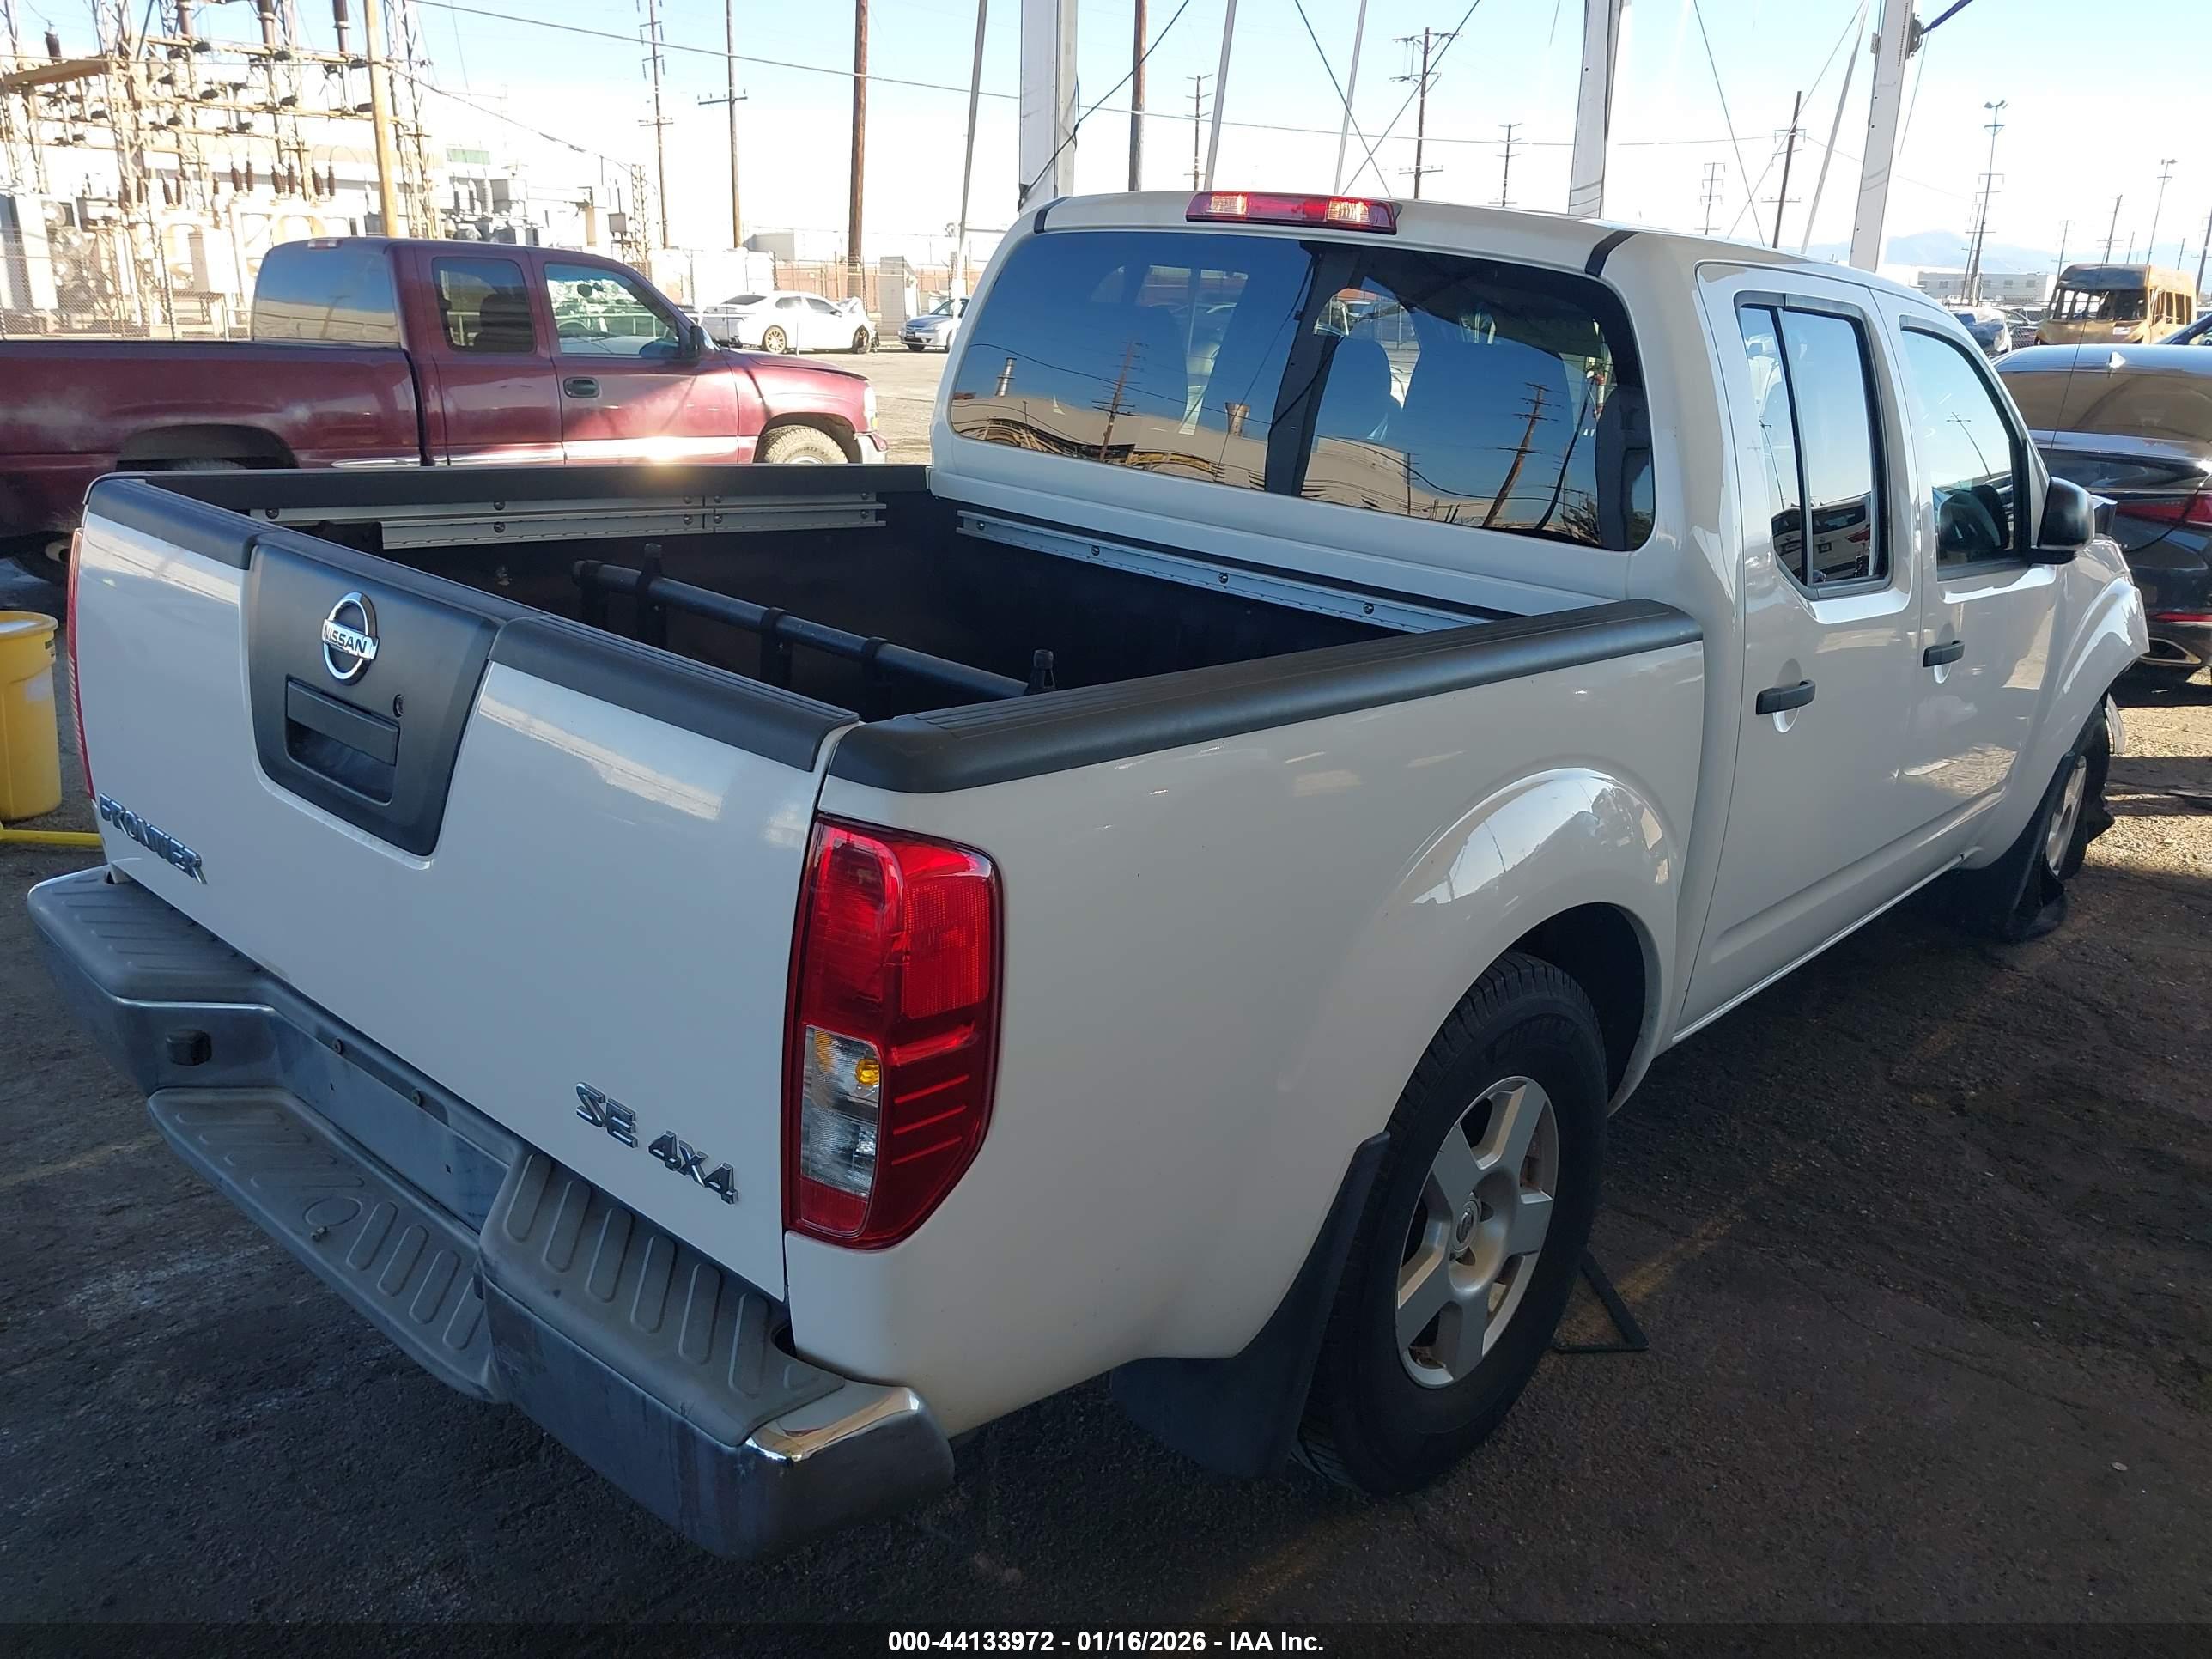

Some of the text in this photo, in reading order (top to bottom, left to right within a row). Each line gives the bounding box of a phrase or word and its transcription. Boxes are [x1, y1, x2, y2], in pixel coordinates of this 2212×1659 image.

[323, 623, 368, 653] NISSAN
[99, 793, 208, 884] FRONTIER
[576, 1082, 638, 1149] SE
